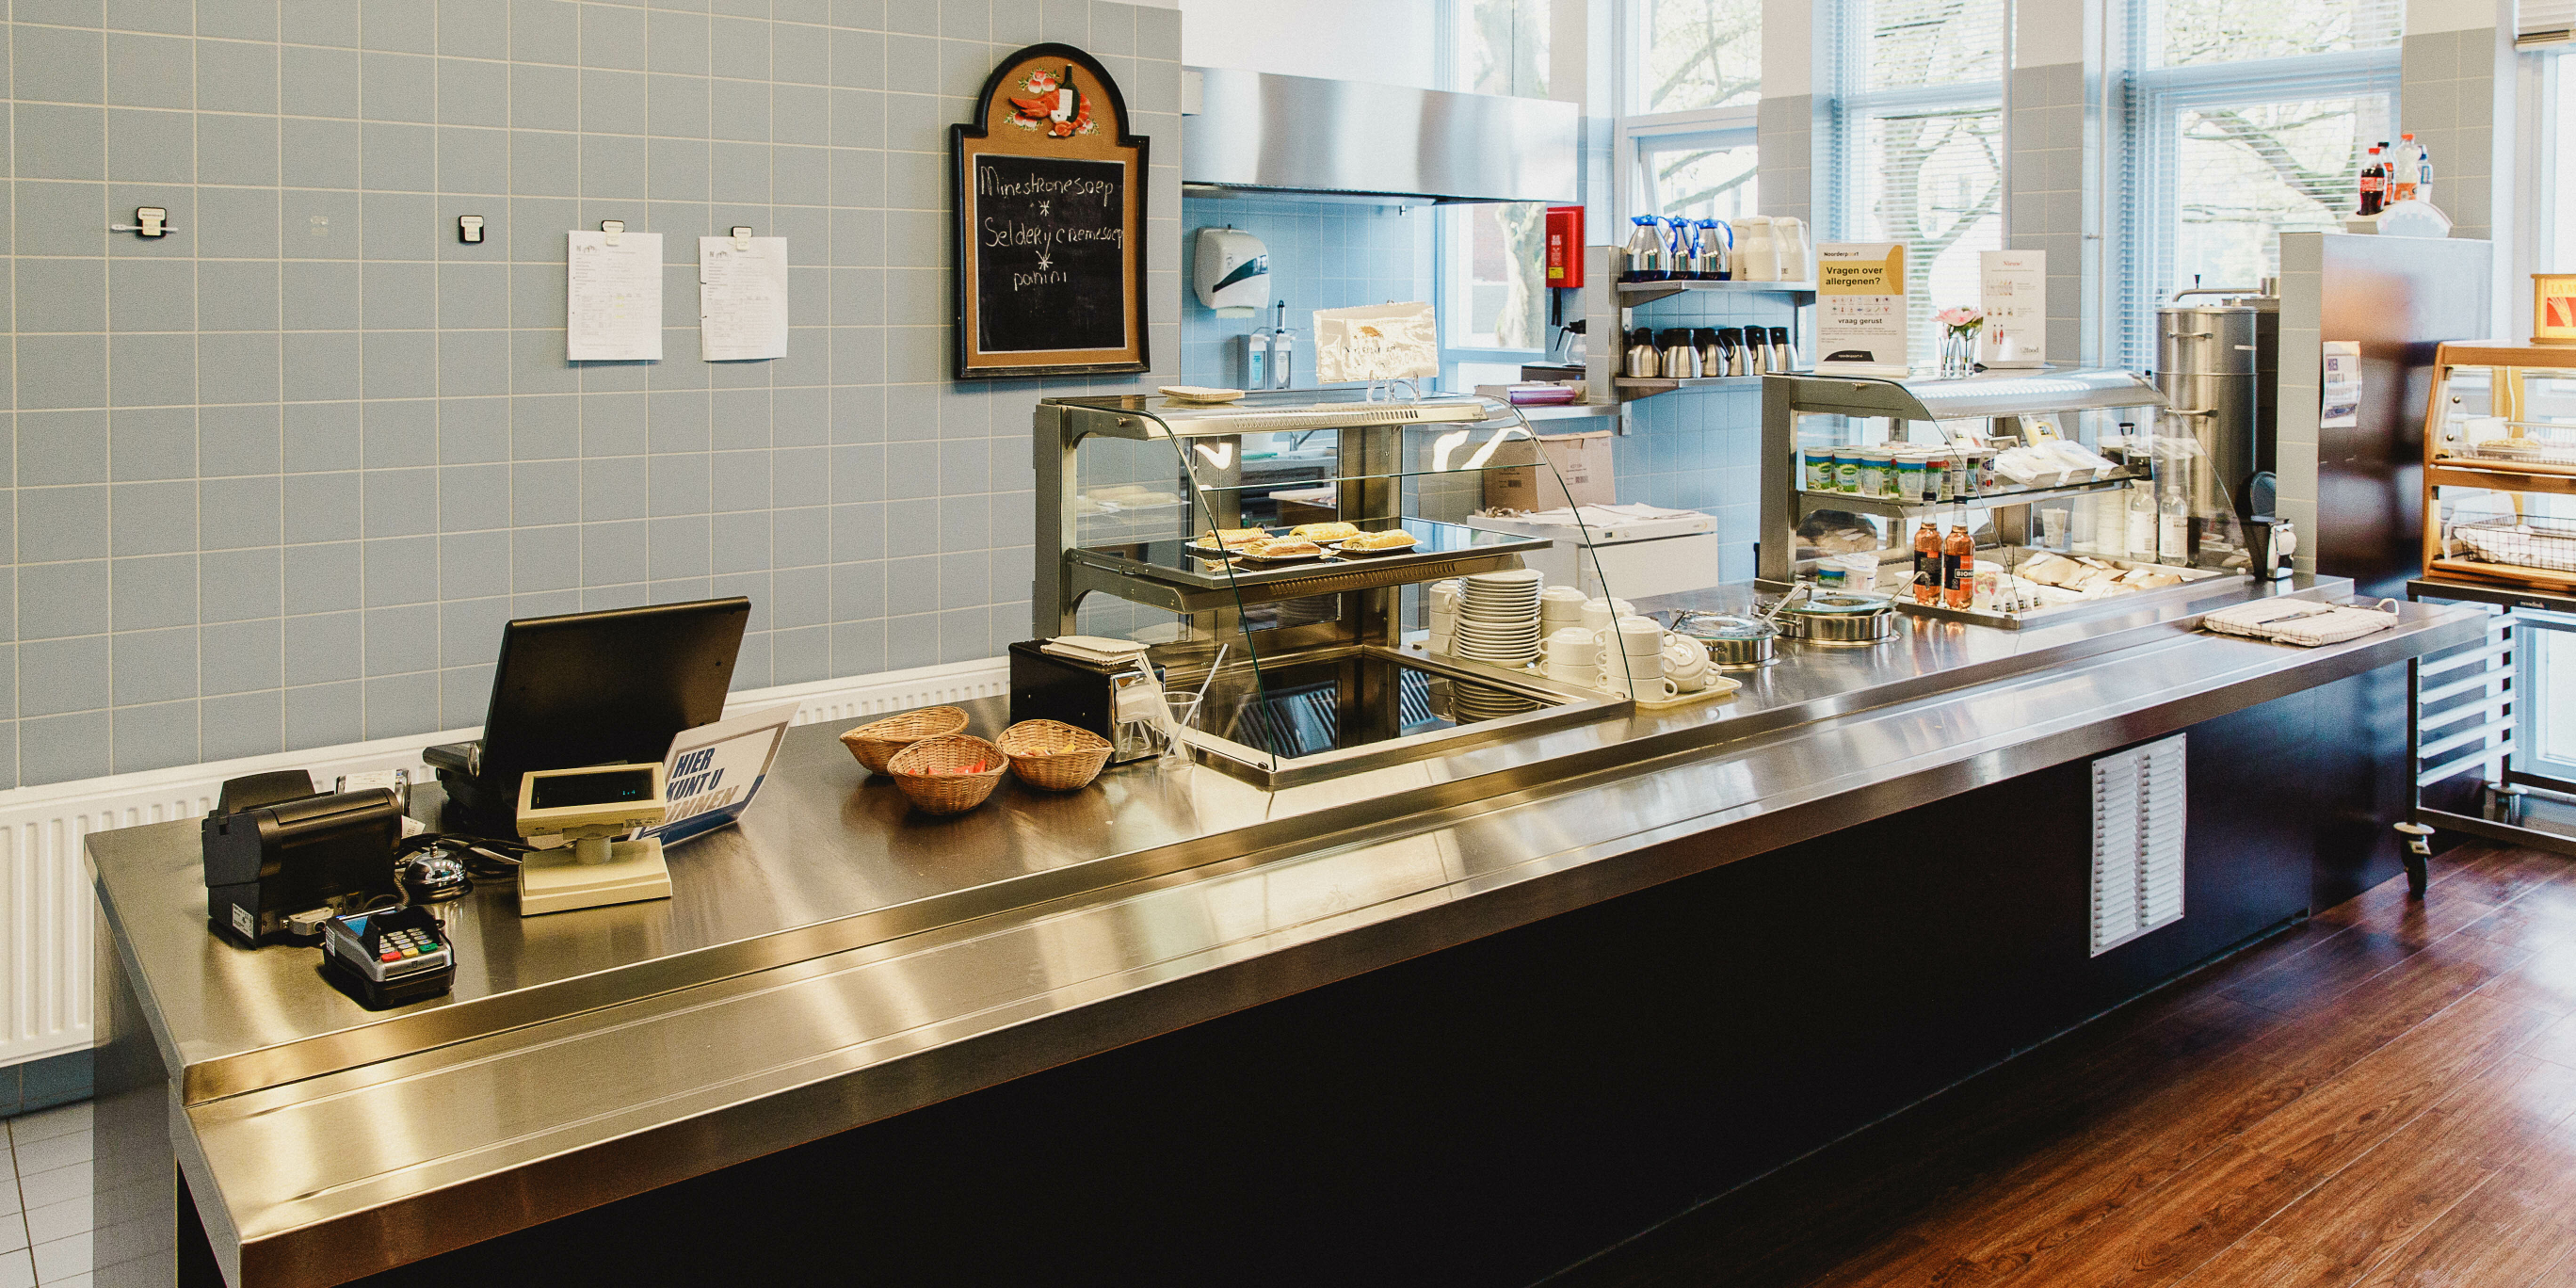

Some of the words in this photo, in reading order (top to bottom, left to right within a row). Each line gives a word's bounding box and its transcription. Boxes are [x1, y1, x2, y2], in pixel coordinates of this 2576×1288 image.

[1013, 270, 1067, 292] panini
[1826, 277, 1881, 287] allergenen?
[1827, 266, 1860, 276] Vragen
[672, 748, 716, 780] HIER
[666, 771, 712, 803] KUNT
[707, 766, 726, 791] U
[665, 784, 740, 824] INNEN
